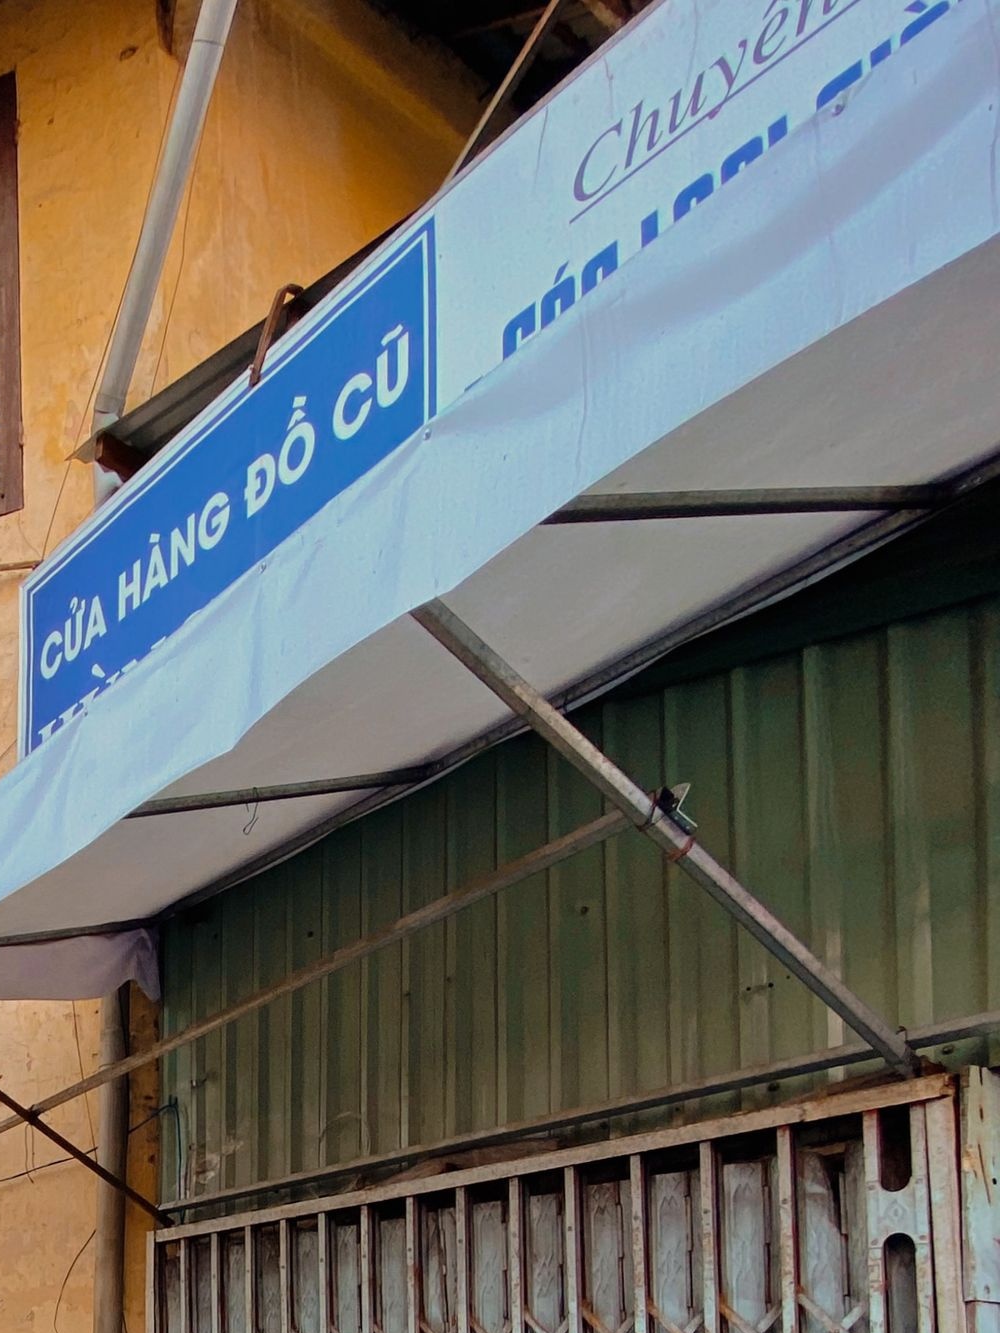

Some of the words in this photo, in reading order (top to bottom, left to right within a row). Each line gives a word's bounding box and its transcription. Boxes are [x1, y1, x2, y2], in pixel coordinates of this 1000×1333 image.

[40, 595, 107, 680] CỬA
[118, 491, 230, 623] HÀNG
[244, 396, 316, 518] ĐỒ
[331, 323, 410, 441] CŨ
